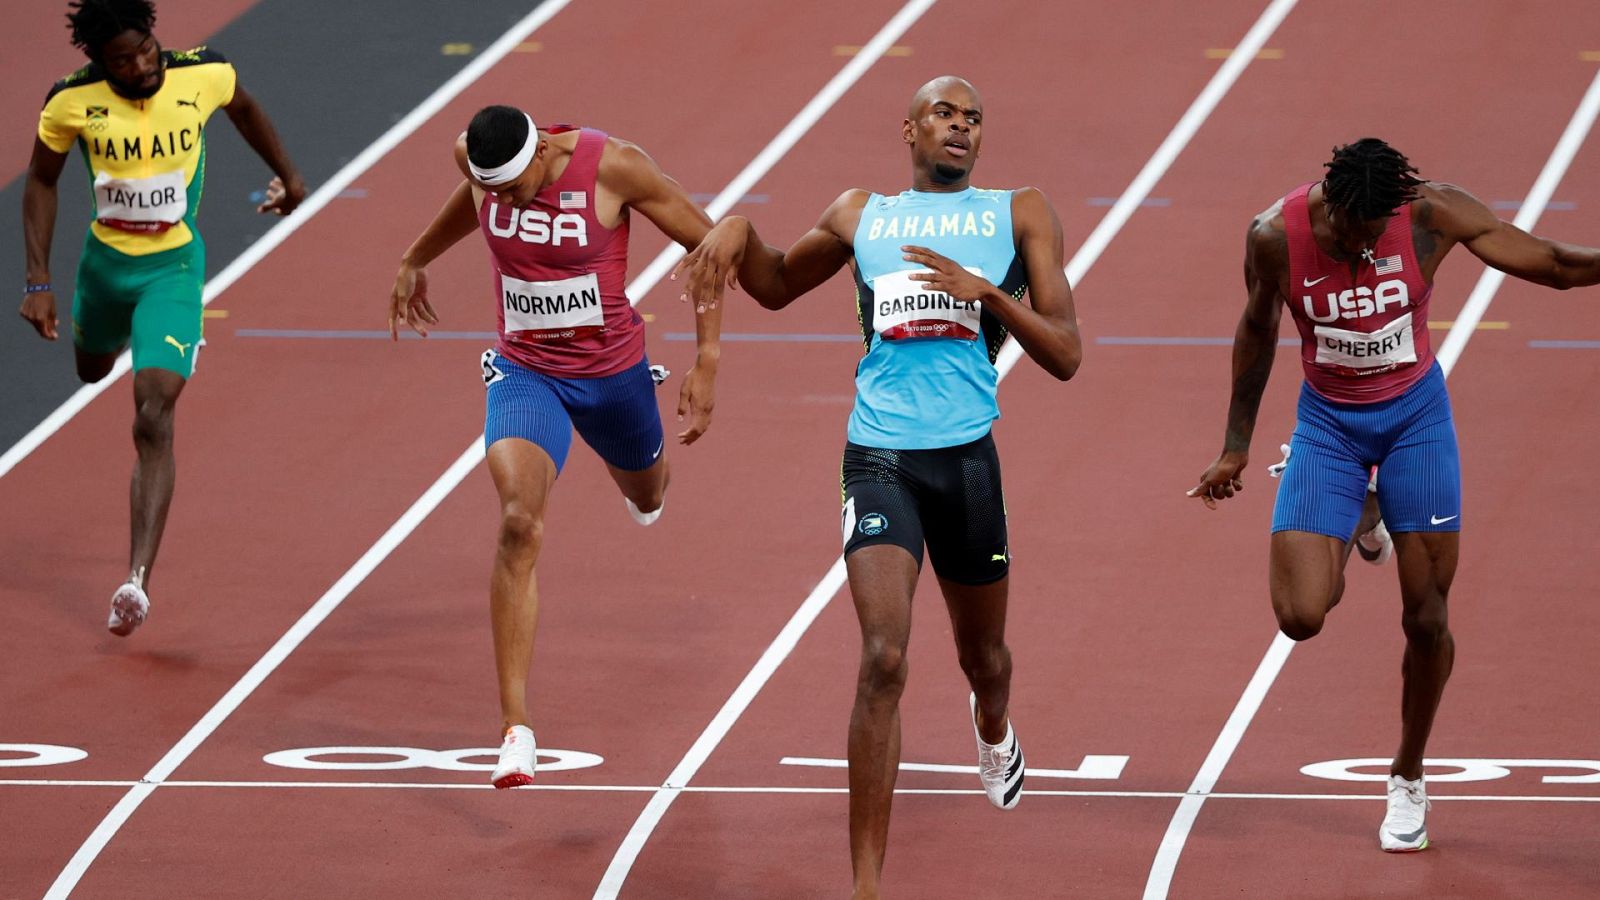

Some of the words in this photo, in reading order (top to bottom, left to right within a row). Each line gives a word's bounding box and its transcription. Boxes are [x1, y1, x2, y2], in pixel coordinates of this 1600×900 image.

[104, 186, 176, 208] TAYLOR
[488, 202, 588, 247] USA
[868, 210, 996, 241] BAHAMAS
[505, 287, 597, 315] NORMAN
[1302, 279, 1409, 323] USA
[1325, 327, 1404, 358] CHERRY
[262, 746, 604, 771] 8
